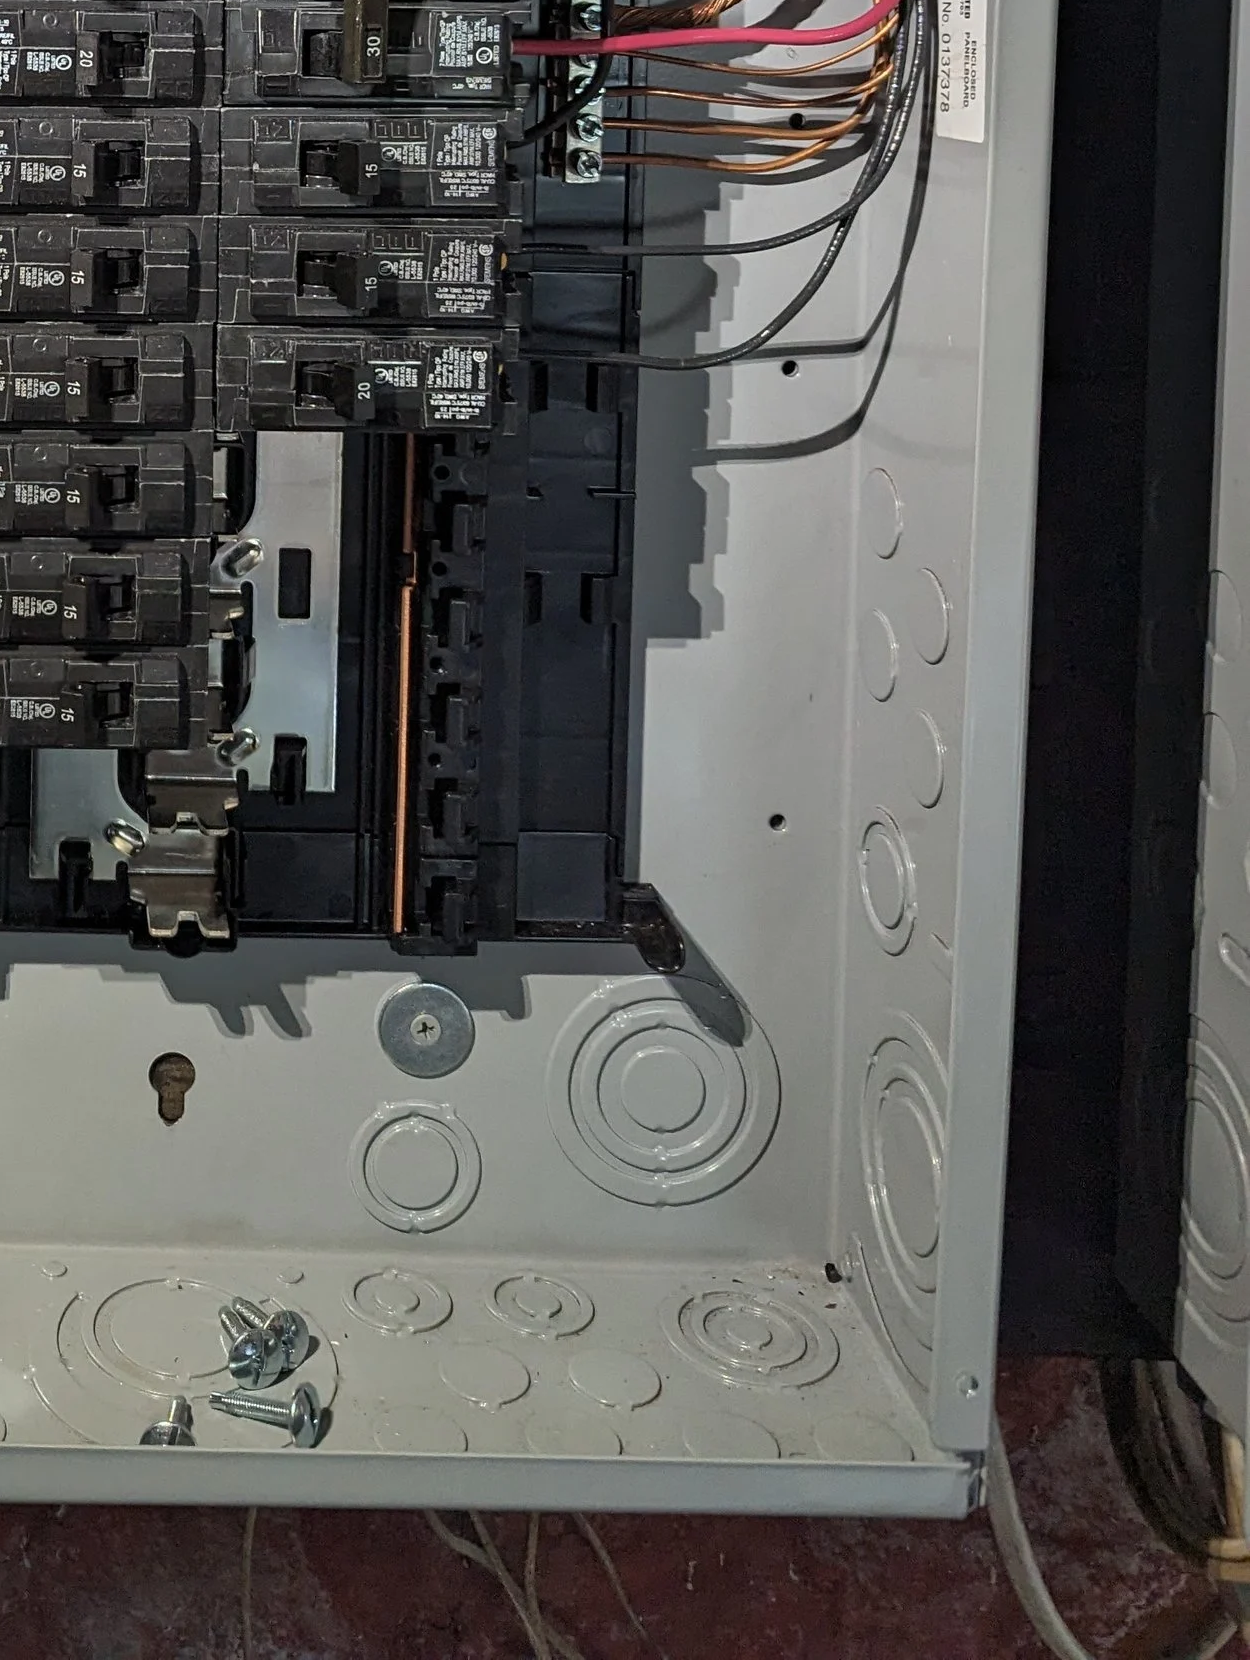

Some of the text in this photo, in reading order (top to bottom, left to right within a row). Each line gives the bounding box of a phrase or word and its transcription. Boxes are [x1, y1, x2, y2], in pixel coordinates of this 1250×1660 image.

[941, 1, 952, 27] No.
[366, 36, 381, 57] 30
[79, 50, 94, 68] 20
[939, 32, 951, 113] 0137378
[73, 163, 87, 178] 15
[365, 163, 378, 179] 15
[70, 270, 85, 285] 15
[364, 276, 378, 292] 15
[66, 380, 81, 395] 15
[357, 382, 371, 400] 20
[66, 488, 81, 504] 15
[63, 604, 78, 620] 15
[60, 707, 75, 723] 15
